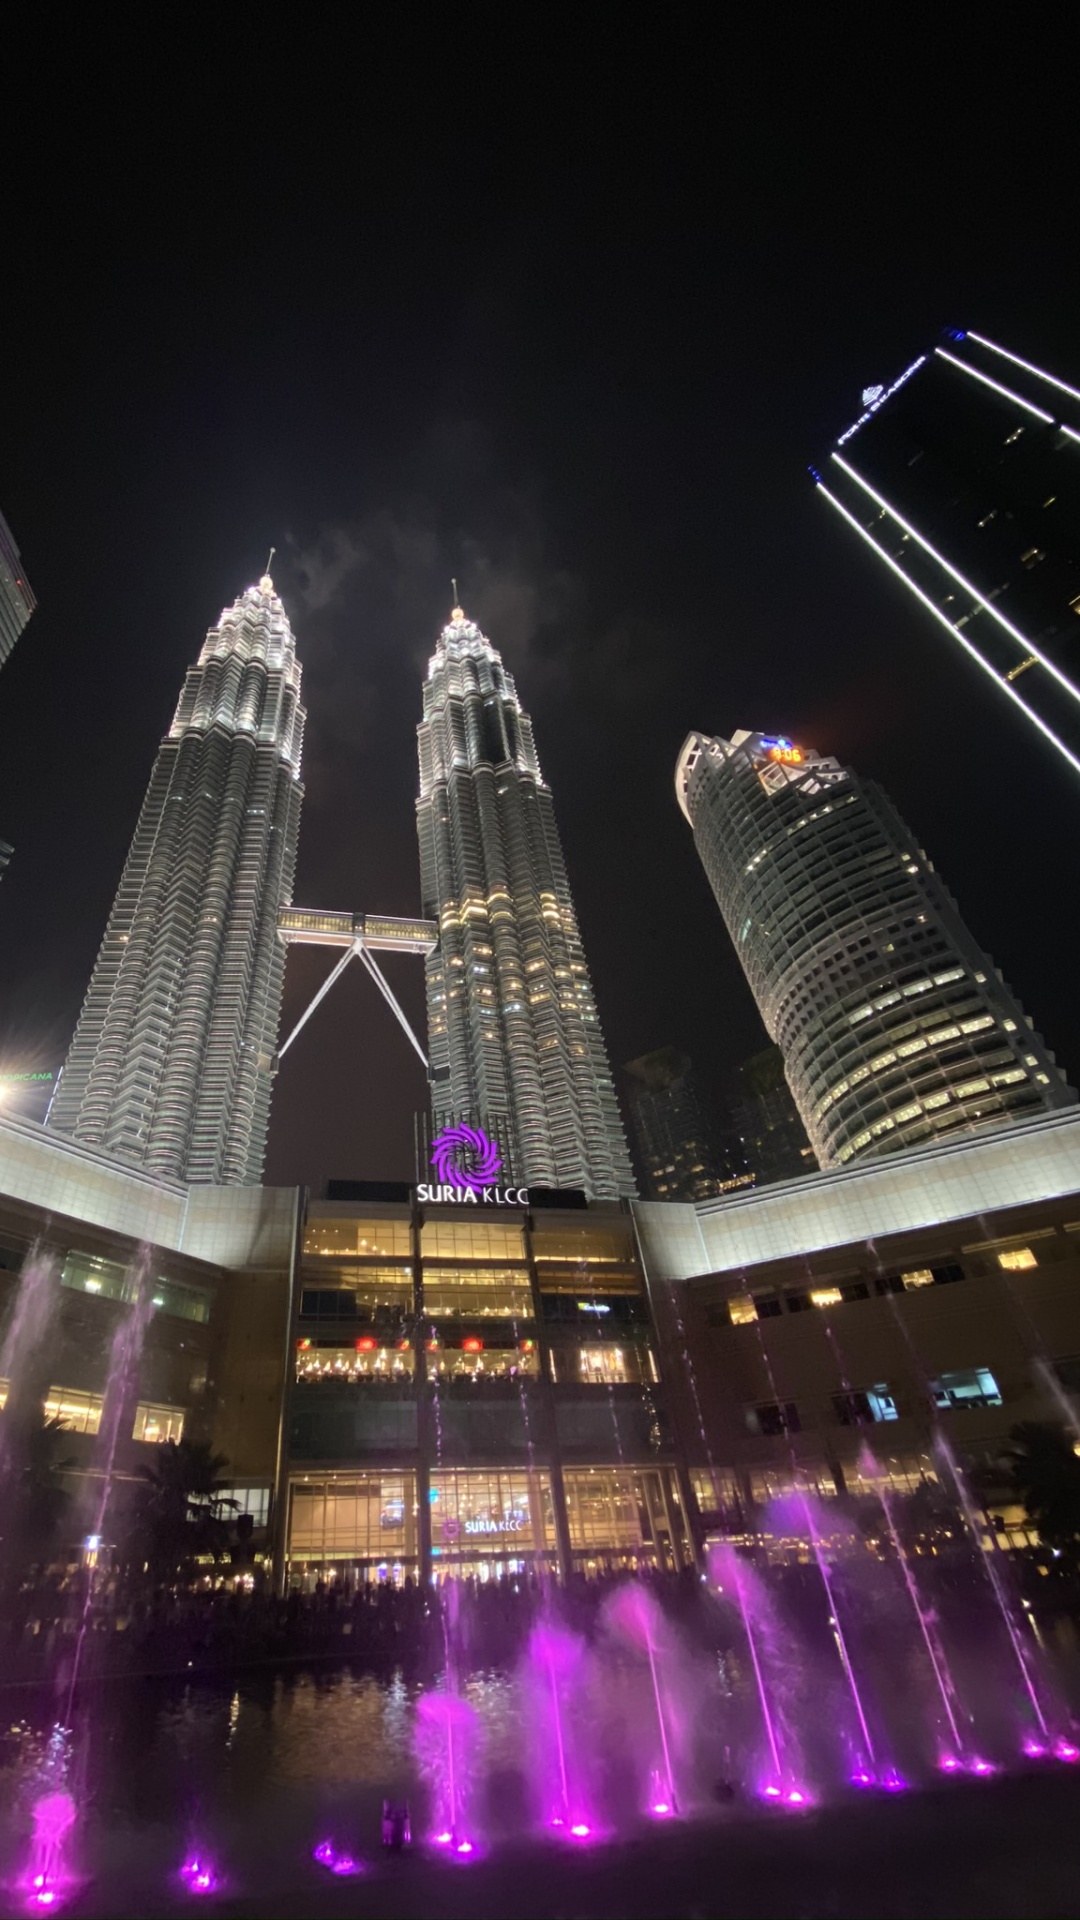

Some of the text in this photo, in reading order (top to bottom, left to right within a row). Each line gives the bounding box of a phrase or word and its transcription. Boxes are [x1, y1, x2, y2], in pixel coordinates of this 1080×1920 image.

[417, 1183, 530, 1205] SURIA KLCC
[465, 1520, 522, 1533] SURIA KLCC
